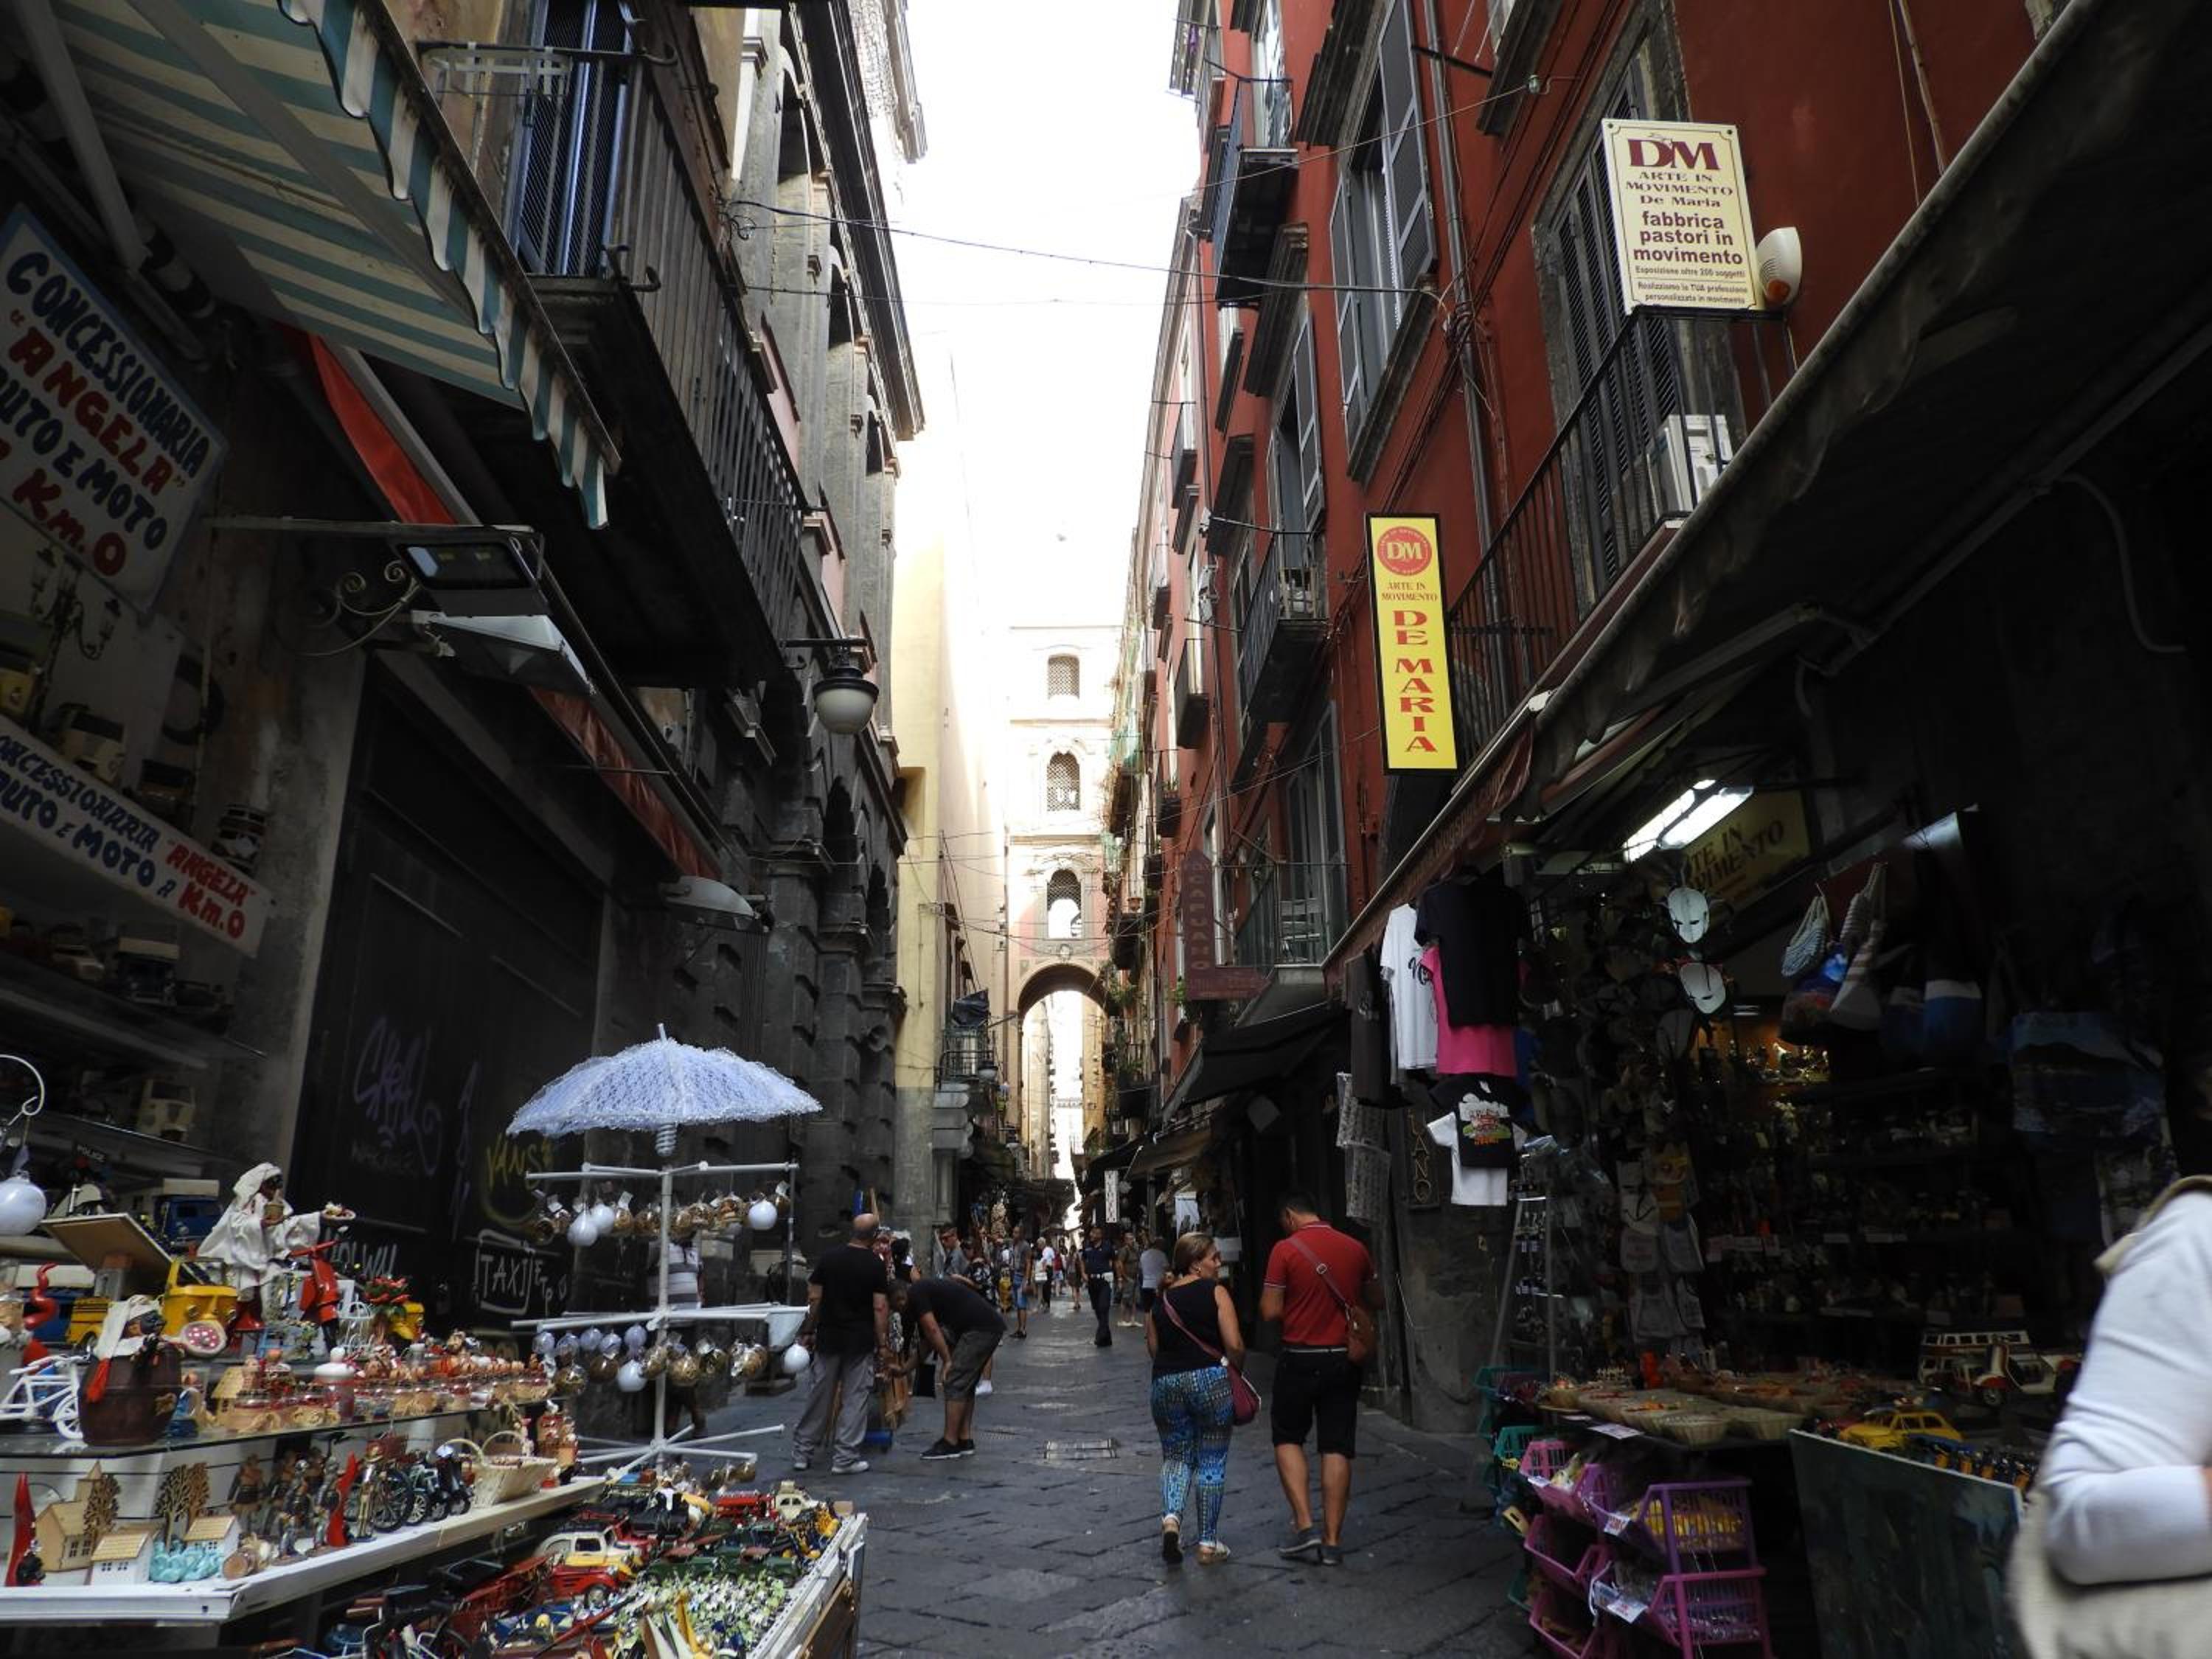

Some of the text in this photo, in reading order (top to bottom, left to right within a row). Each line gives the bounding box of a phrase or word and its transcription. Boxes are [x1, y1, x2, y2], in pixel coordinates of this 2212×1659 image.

[1627, 139, 1721, 170] DM
[1639, 171, 1713, 183] ARTE IN
[1626, 181, 1733, 195] MOVIMENTO
[1640, 195, 1722, 208] De Maria
[1642, 210, 1725, 229] fabbrica
[1640, 229, 1734, 246] pastori in
[1633, 247, 1744, 265] movimento
[1635, 265, 1680, 276] Esposizione
[7, 252, 210, 478] CONCESSIONARIA
[0, 366, 167, 551] UTO E MOTO
[1387, 542, 1423, 560] DM
[1388, 581, 1426, 591] ARTE IN
[1381, 591, 1438, 602] MOVIMENTO
[1394, 610, 1429, 646] DE
[1395, 658, 1438, 754] MARIA
[73, 824, 156, 887] MOTO
